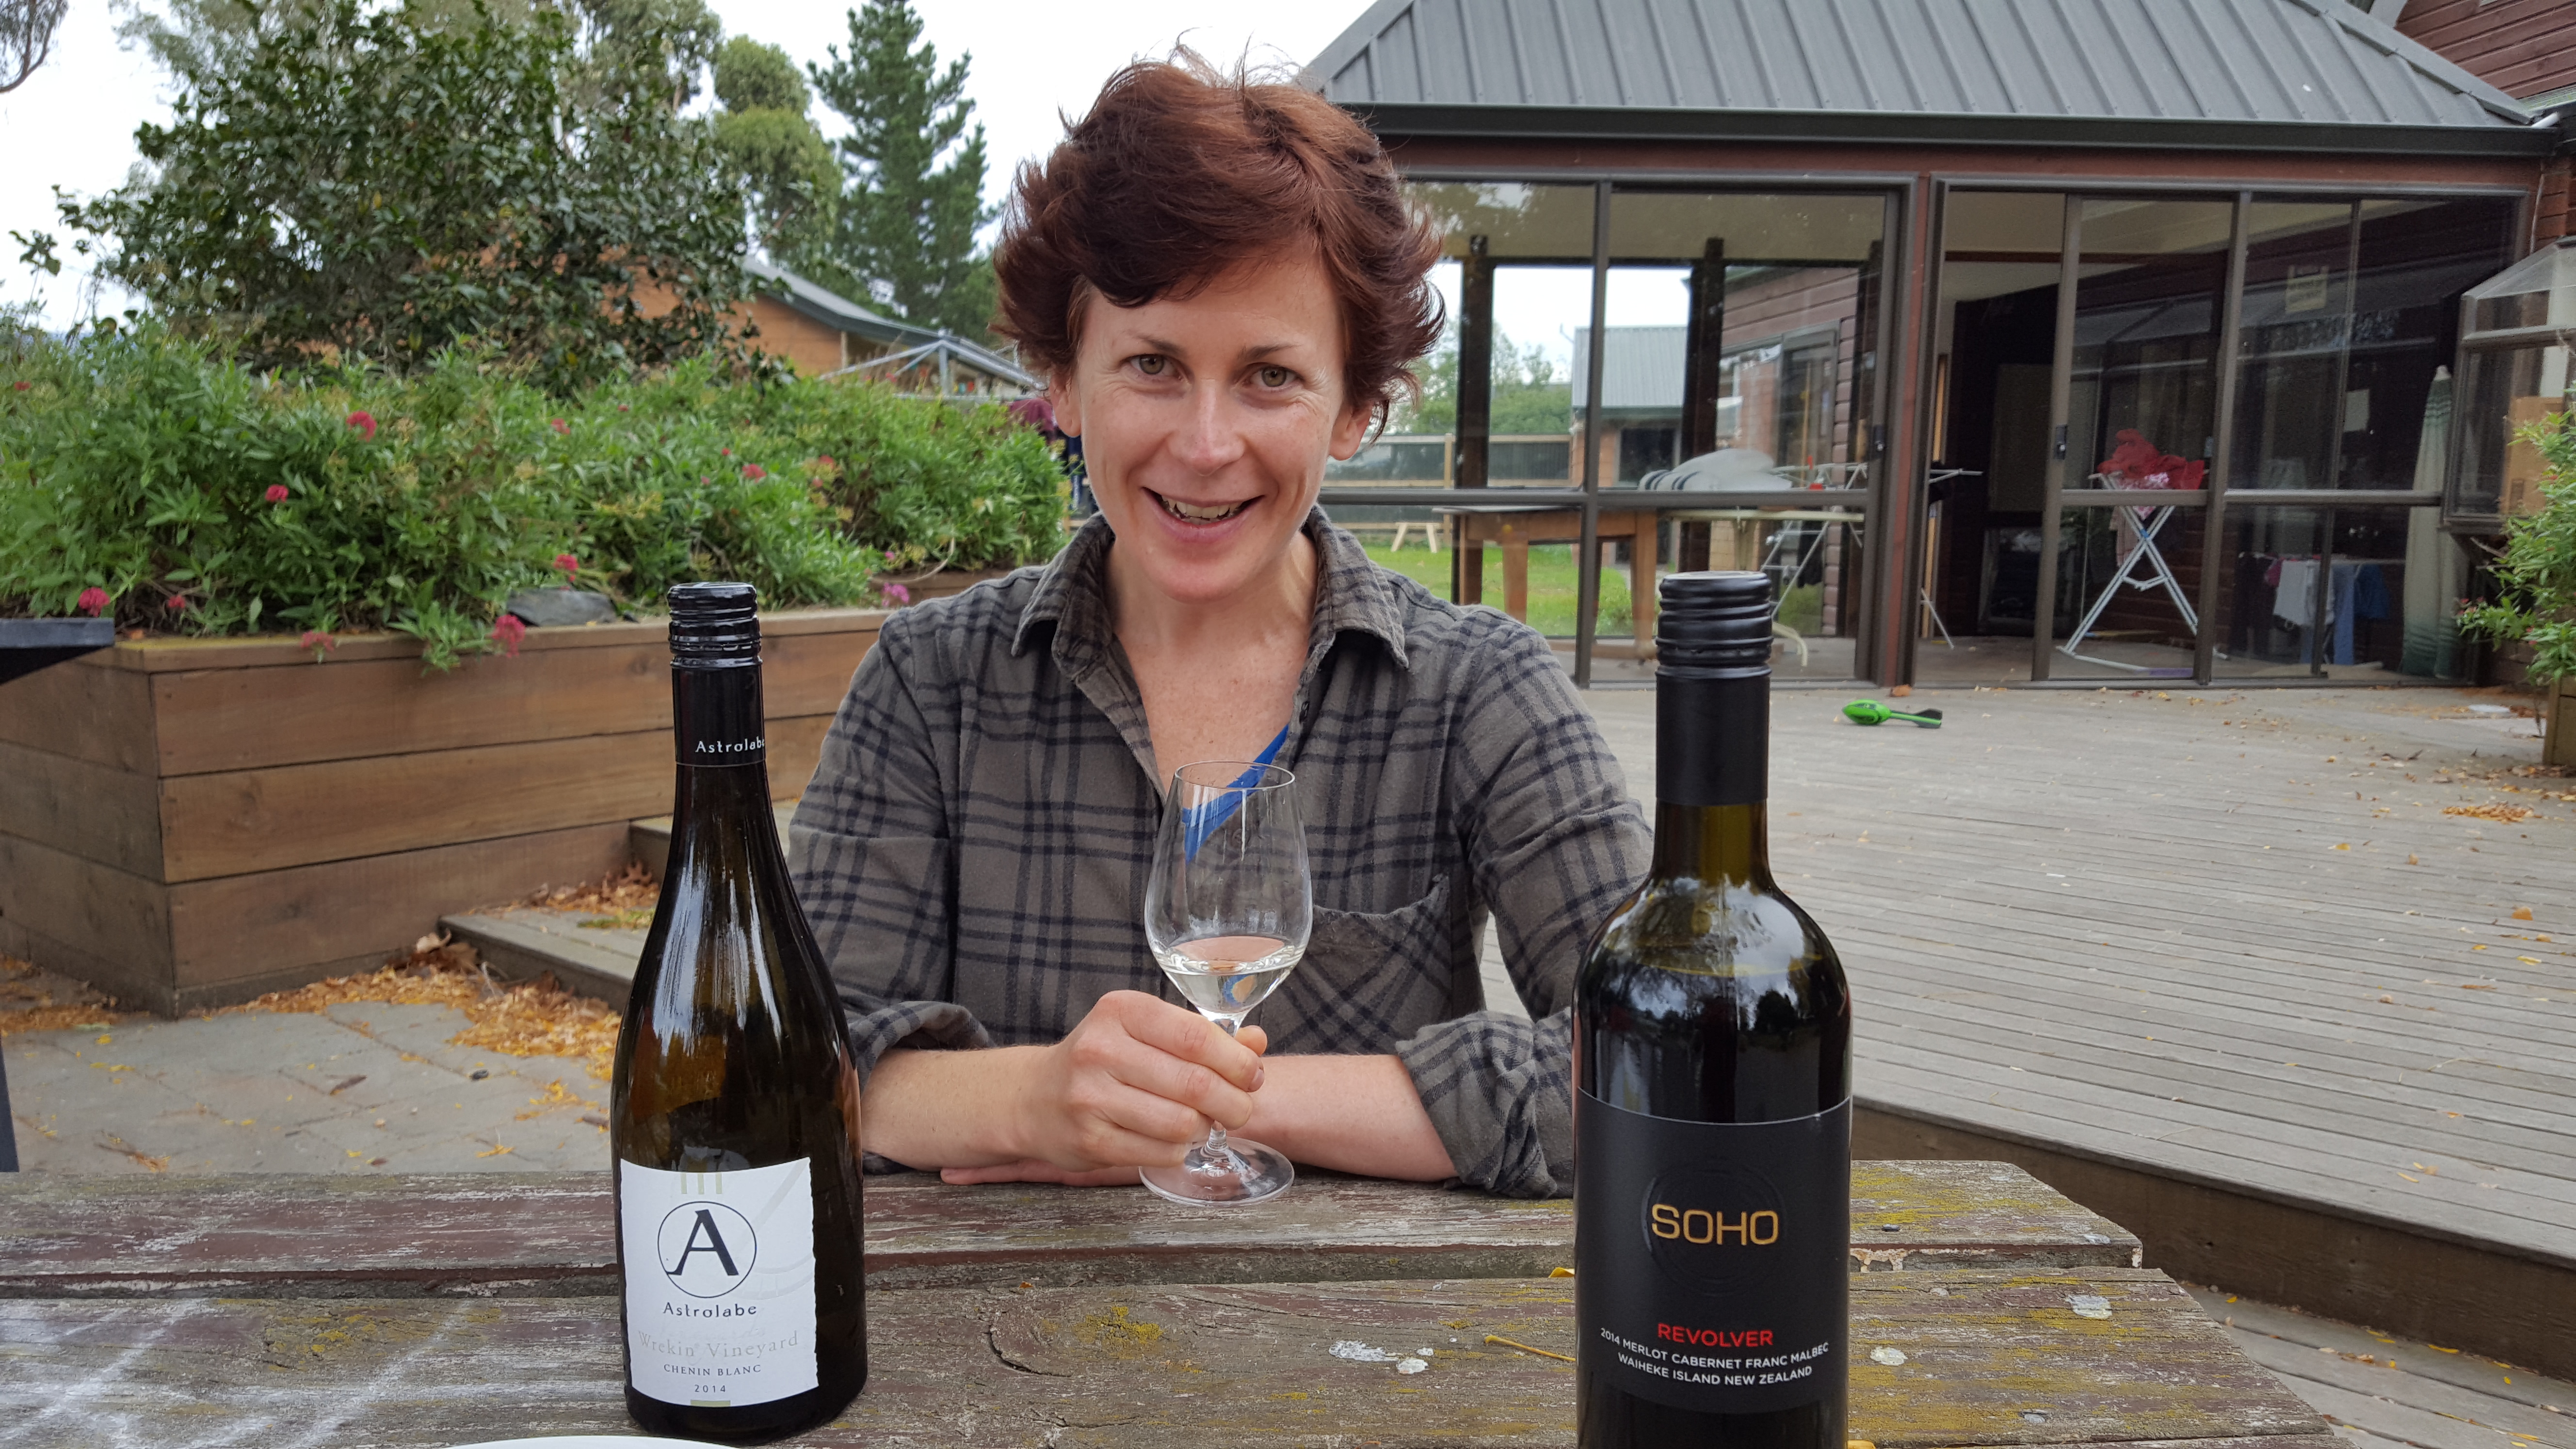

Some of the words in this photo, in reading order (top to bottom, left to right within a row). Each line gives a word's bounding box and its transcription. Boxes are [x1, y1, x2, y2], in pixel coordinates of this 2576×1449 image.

[1652, 1204, 1779, 1245] SOHO
[664, 1209, 739, 1276] A
[662, 1302, 757, 1318] Astrolabe
[707, 1330, 798, 1358] Vineyard
[1600, 1327, 1620, 1345] 2014
[1623, 1339, 1667, 1360] MERLOT
[1672, 1353, 1741, 1369] CABERNET
[1746, 1355, 1787, 1368] FRANC
[1791, 1342, 1829, 1364] MALBEC
[1657, 1322, 1773, 1347] REVOLVER
[664, 1364, 710, 1376] CHENIN
[718, 1364, 761, 1376] BLANC
[1618, 1352, 1669, 1378] WAIHEKE
[1673, 1370, 1720, 1385] ISLAND
[1724, 1375, 1755, 1385] NEW
[1759, 1365, 1812, 1385] ZEALAND
[694, 1384, 726, 1393] 2014
